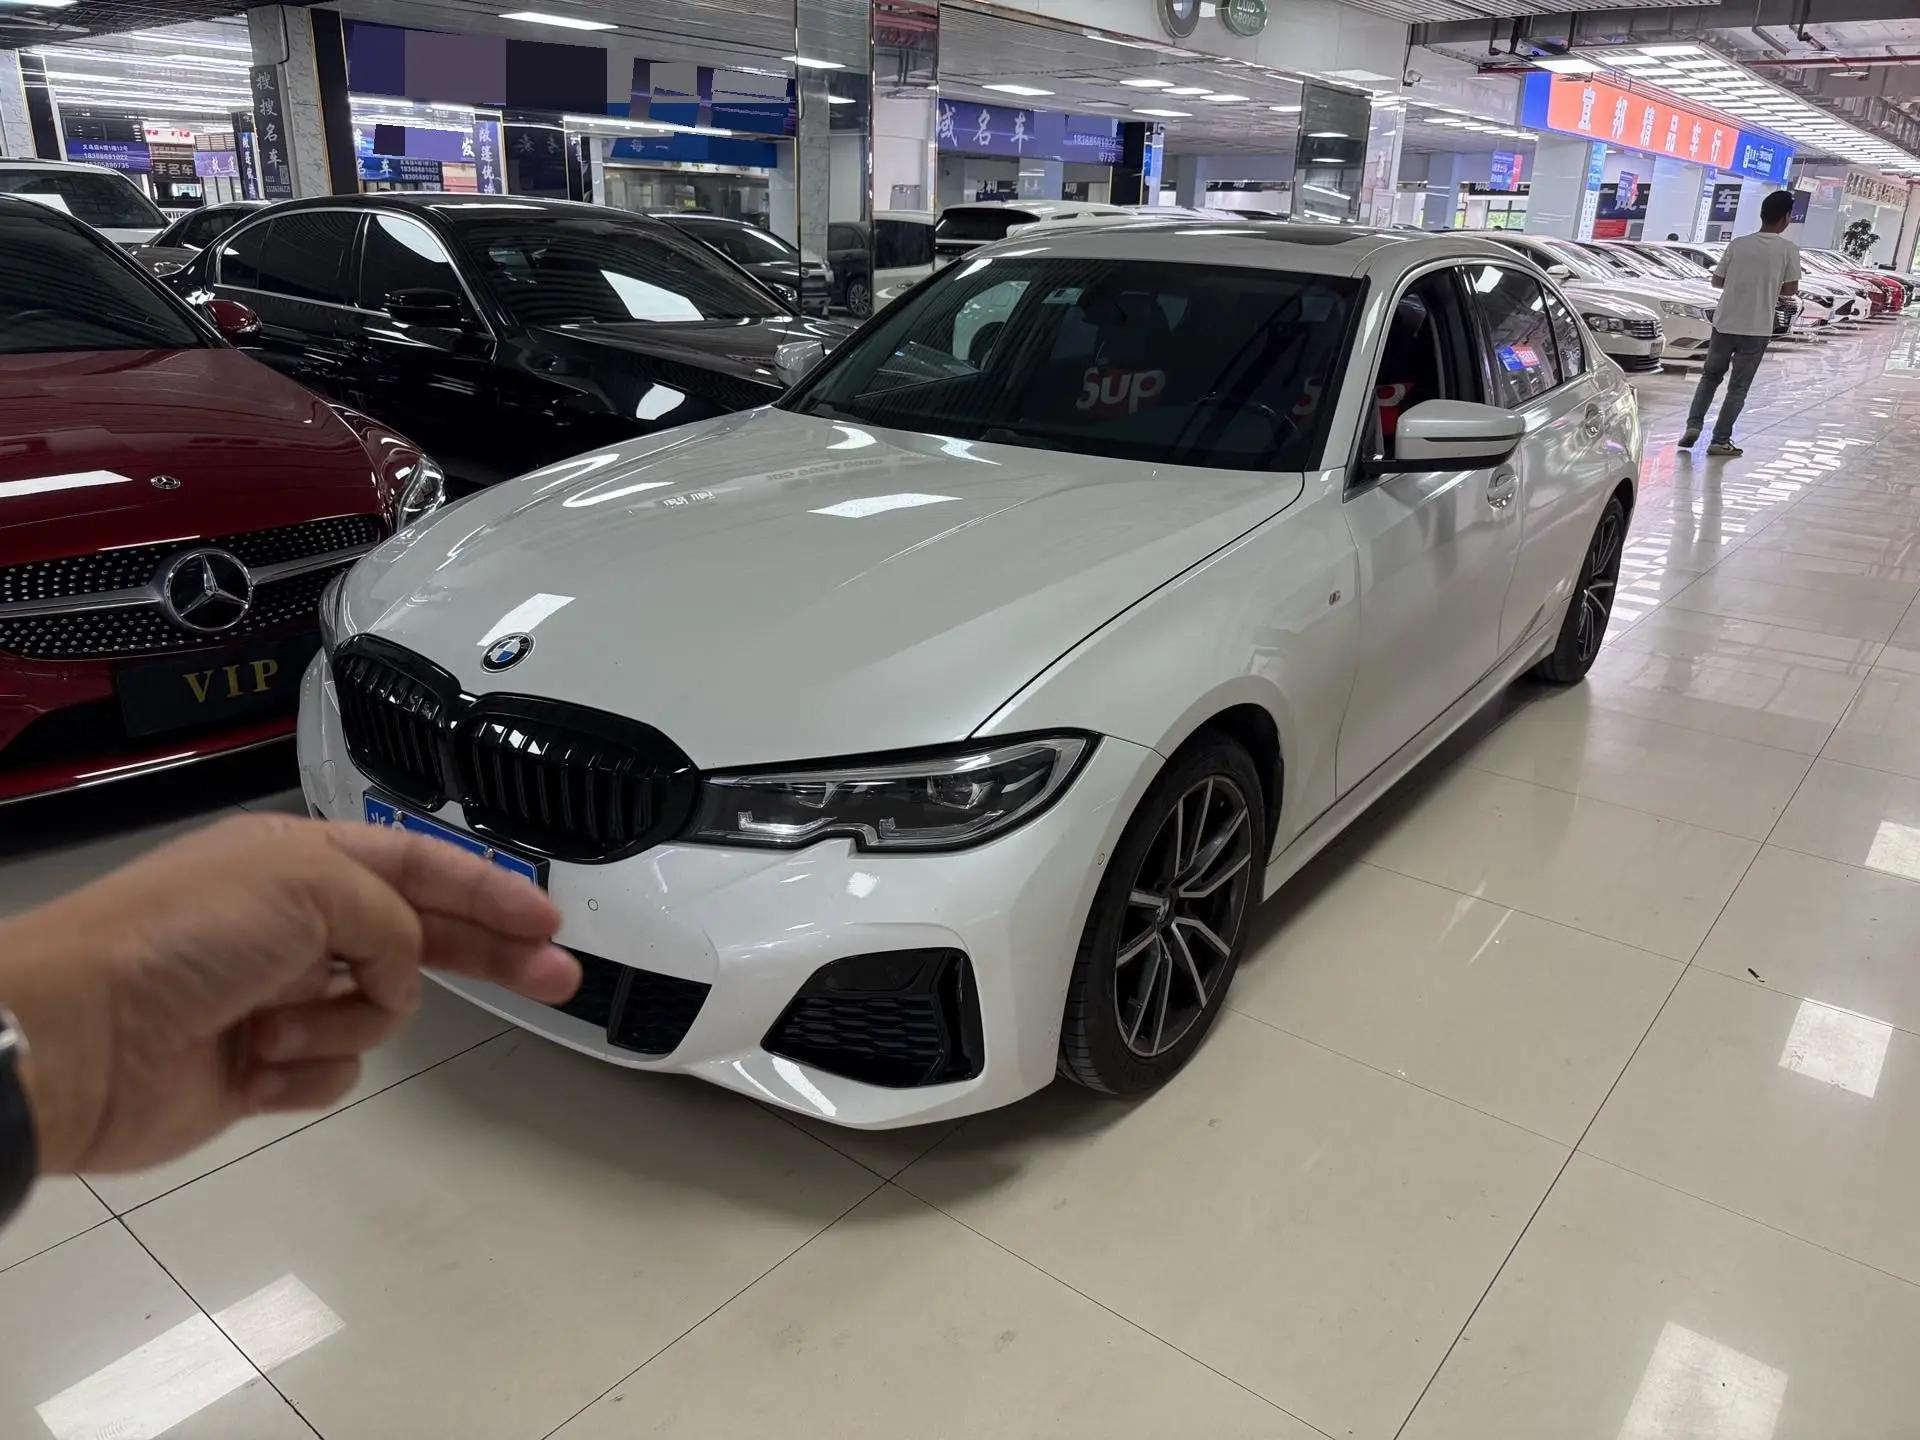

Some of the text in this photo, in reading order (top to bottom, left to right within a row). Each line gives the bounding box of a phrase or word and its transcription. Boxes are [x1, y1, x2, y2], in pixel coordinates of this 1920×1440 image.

[256, 71, 282, 168] 搜搜名车
[182, 658, 279, 703] VIP
